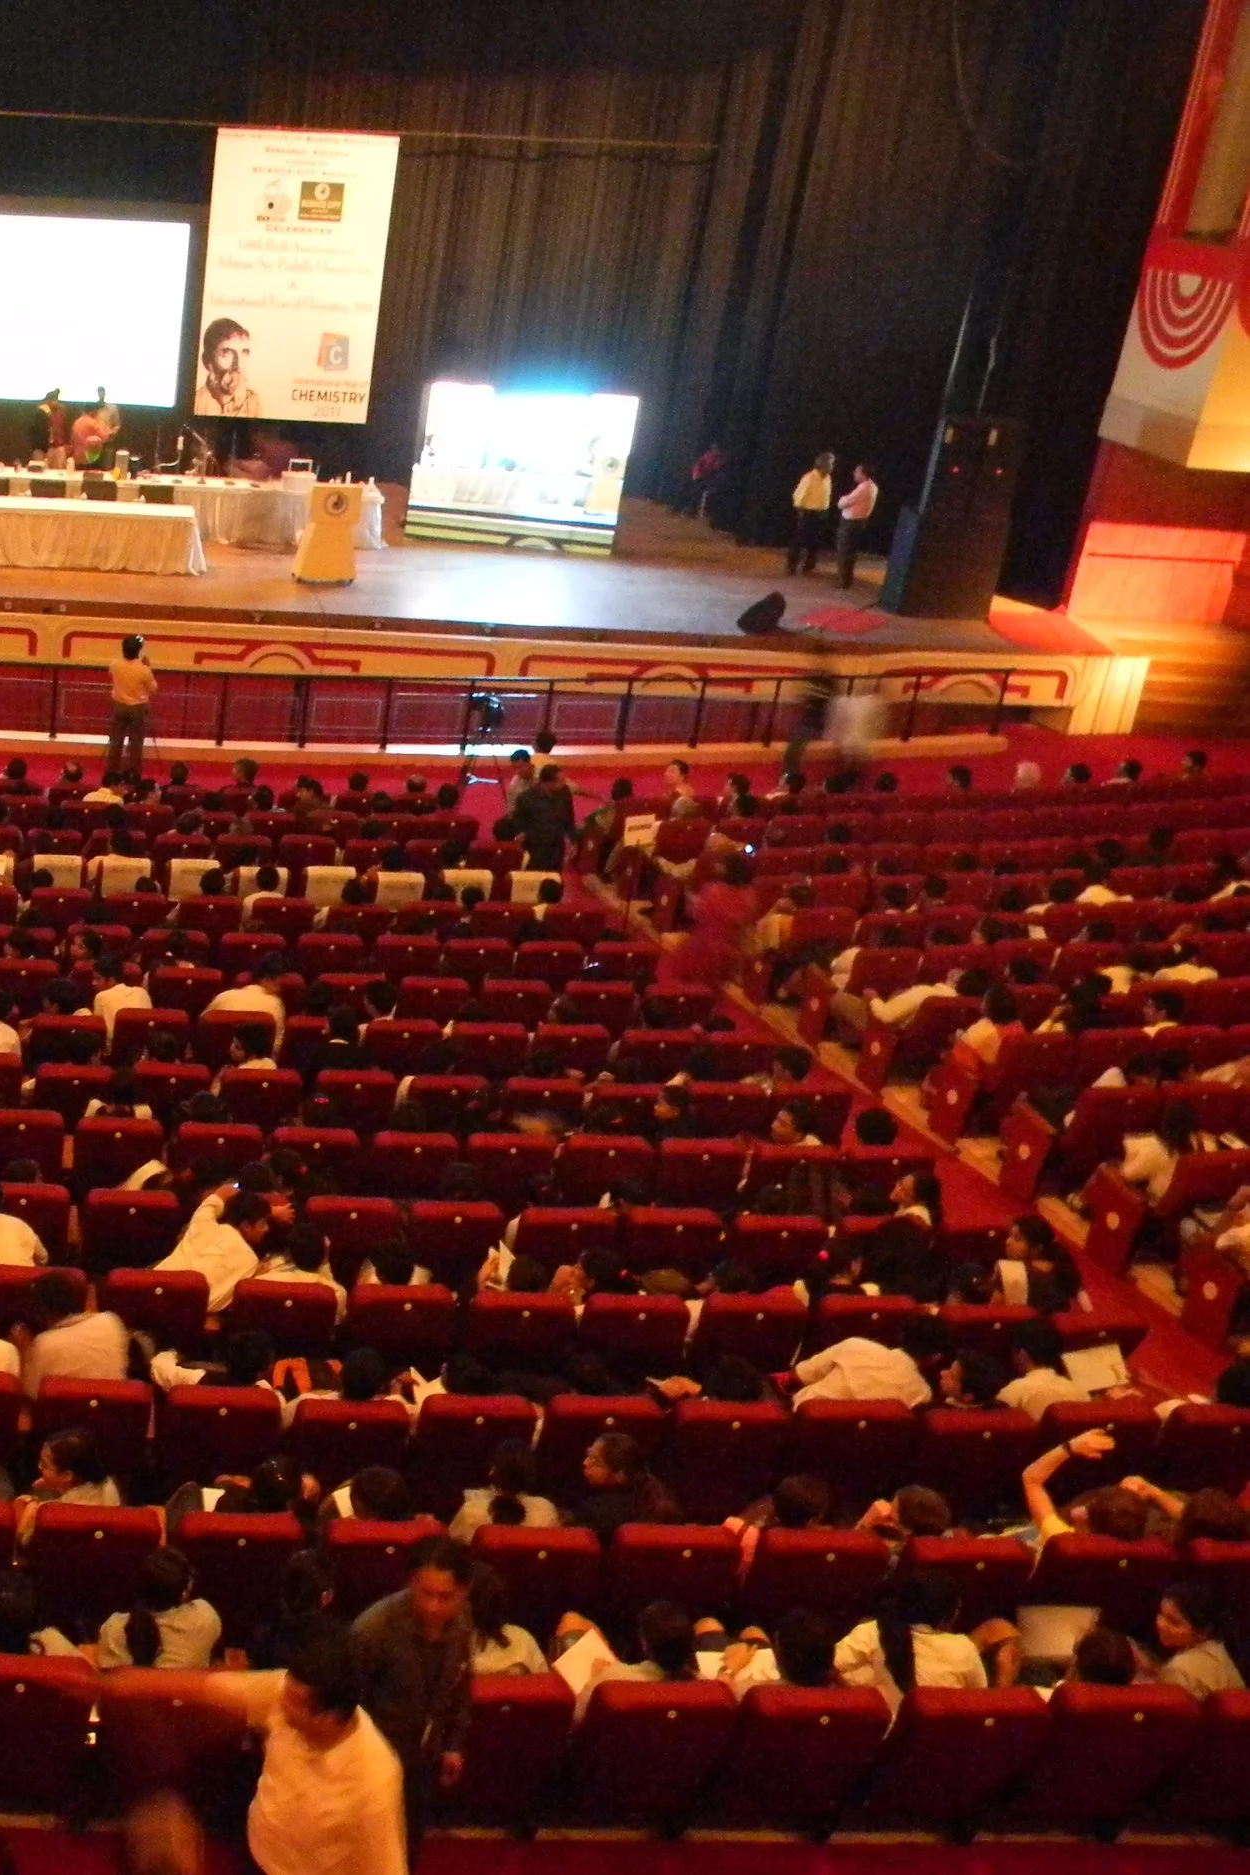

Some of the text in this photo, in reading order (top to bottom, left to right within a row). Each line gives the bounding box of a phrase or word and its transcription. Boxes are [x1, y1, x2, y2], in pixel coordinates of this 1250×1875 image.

[330, 345, 343, 365] C
[291, 388, 366, 404] CHEMISTRY
[313, 404, 341, 417] 2011
